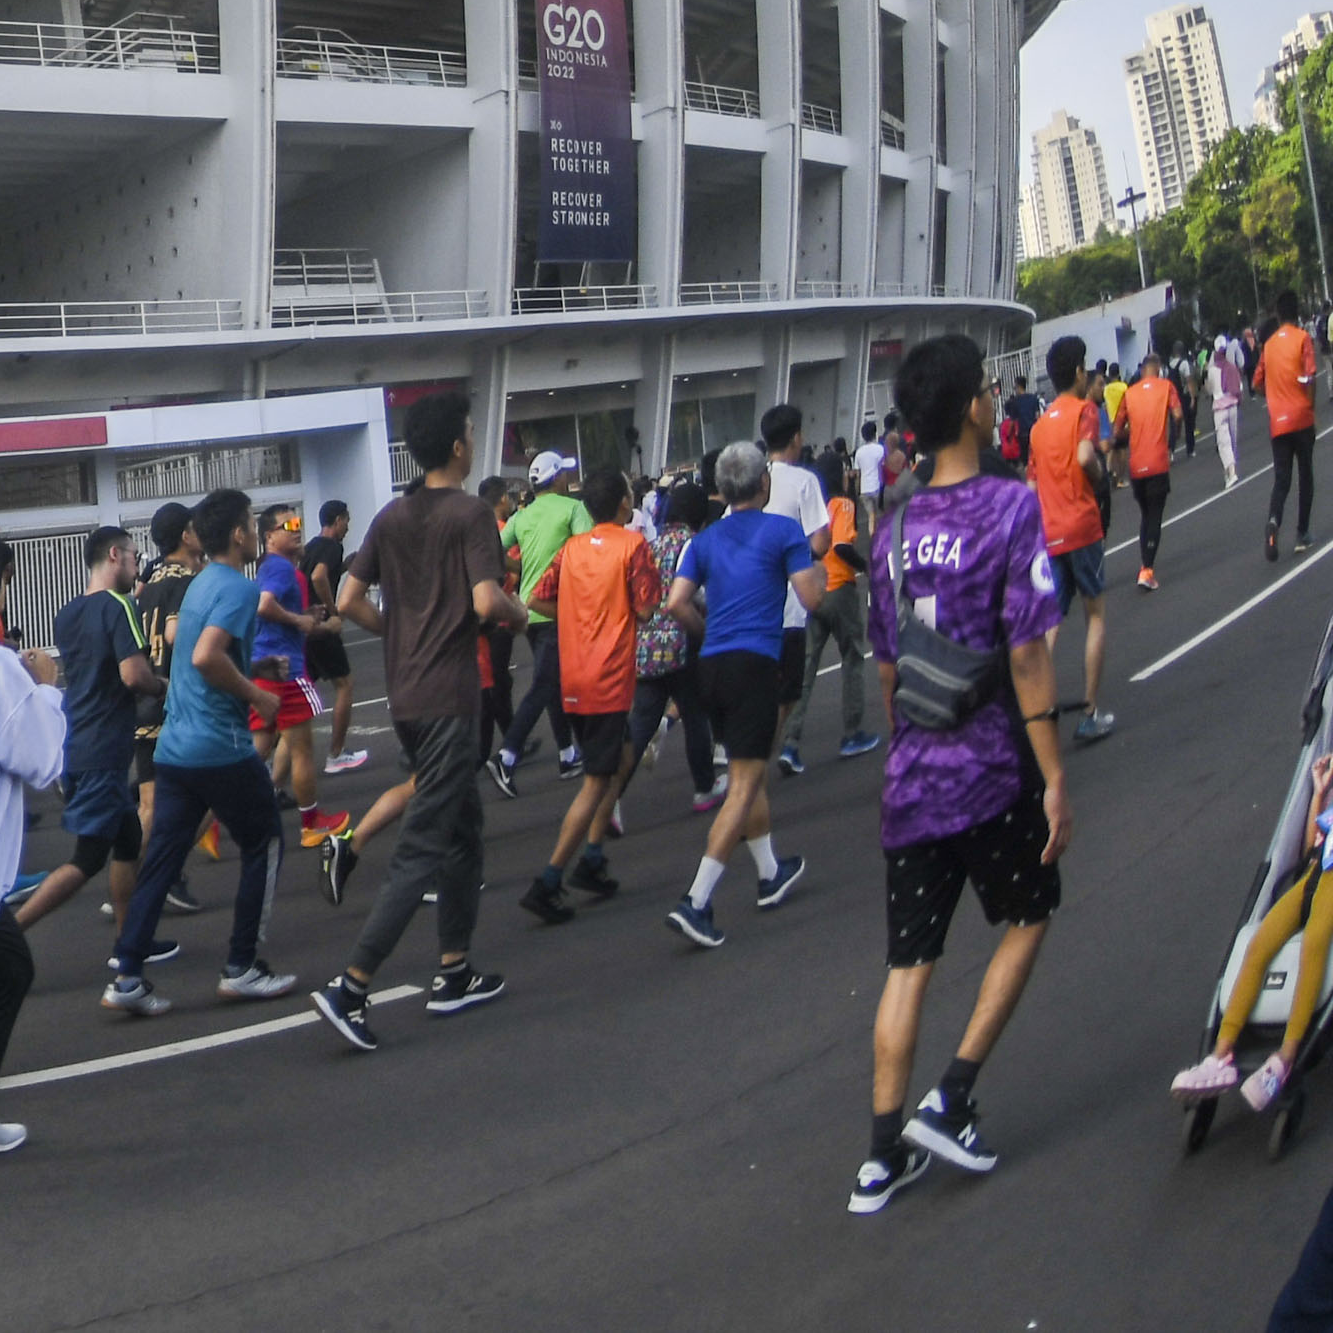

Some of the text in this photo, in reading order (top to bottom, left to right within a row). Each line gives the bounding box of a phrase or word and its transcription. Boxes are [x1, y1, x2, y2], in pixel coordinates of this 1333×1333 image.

[543, 3, 606, 52] G20
[545, 46, 608, 68] INDONESIA
[547, 64, 575, 80] 2022
[551, 137, 602, 156] RECOVER
[551, 156, 611, 175] TOGETHER
[551, 191, 602, 208] RECOVER
[551, 210, 611, 227] STRONGER
[916, 531, 962, 571] GEA
